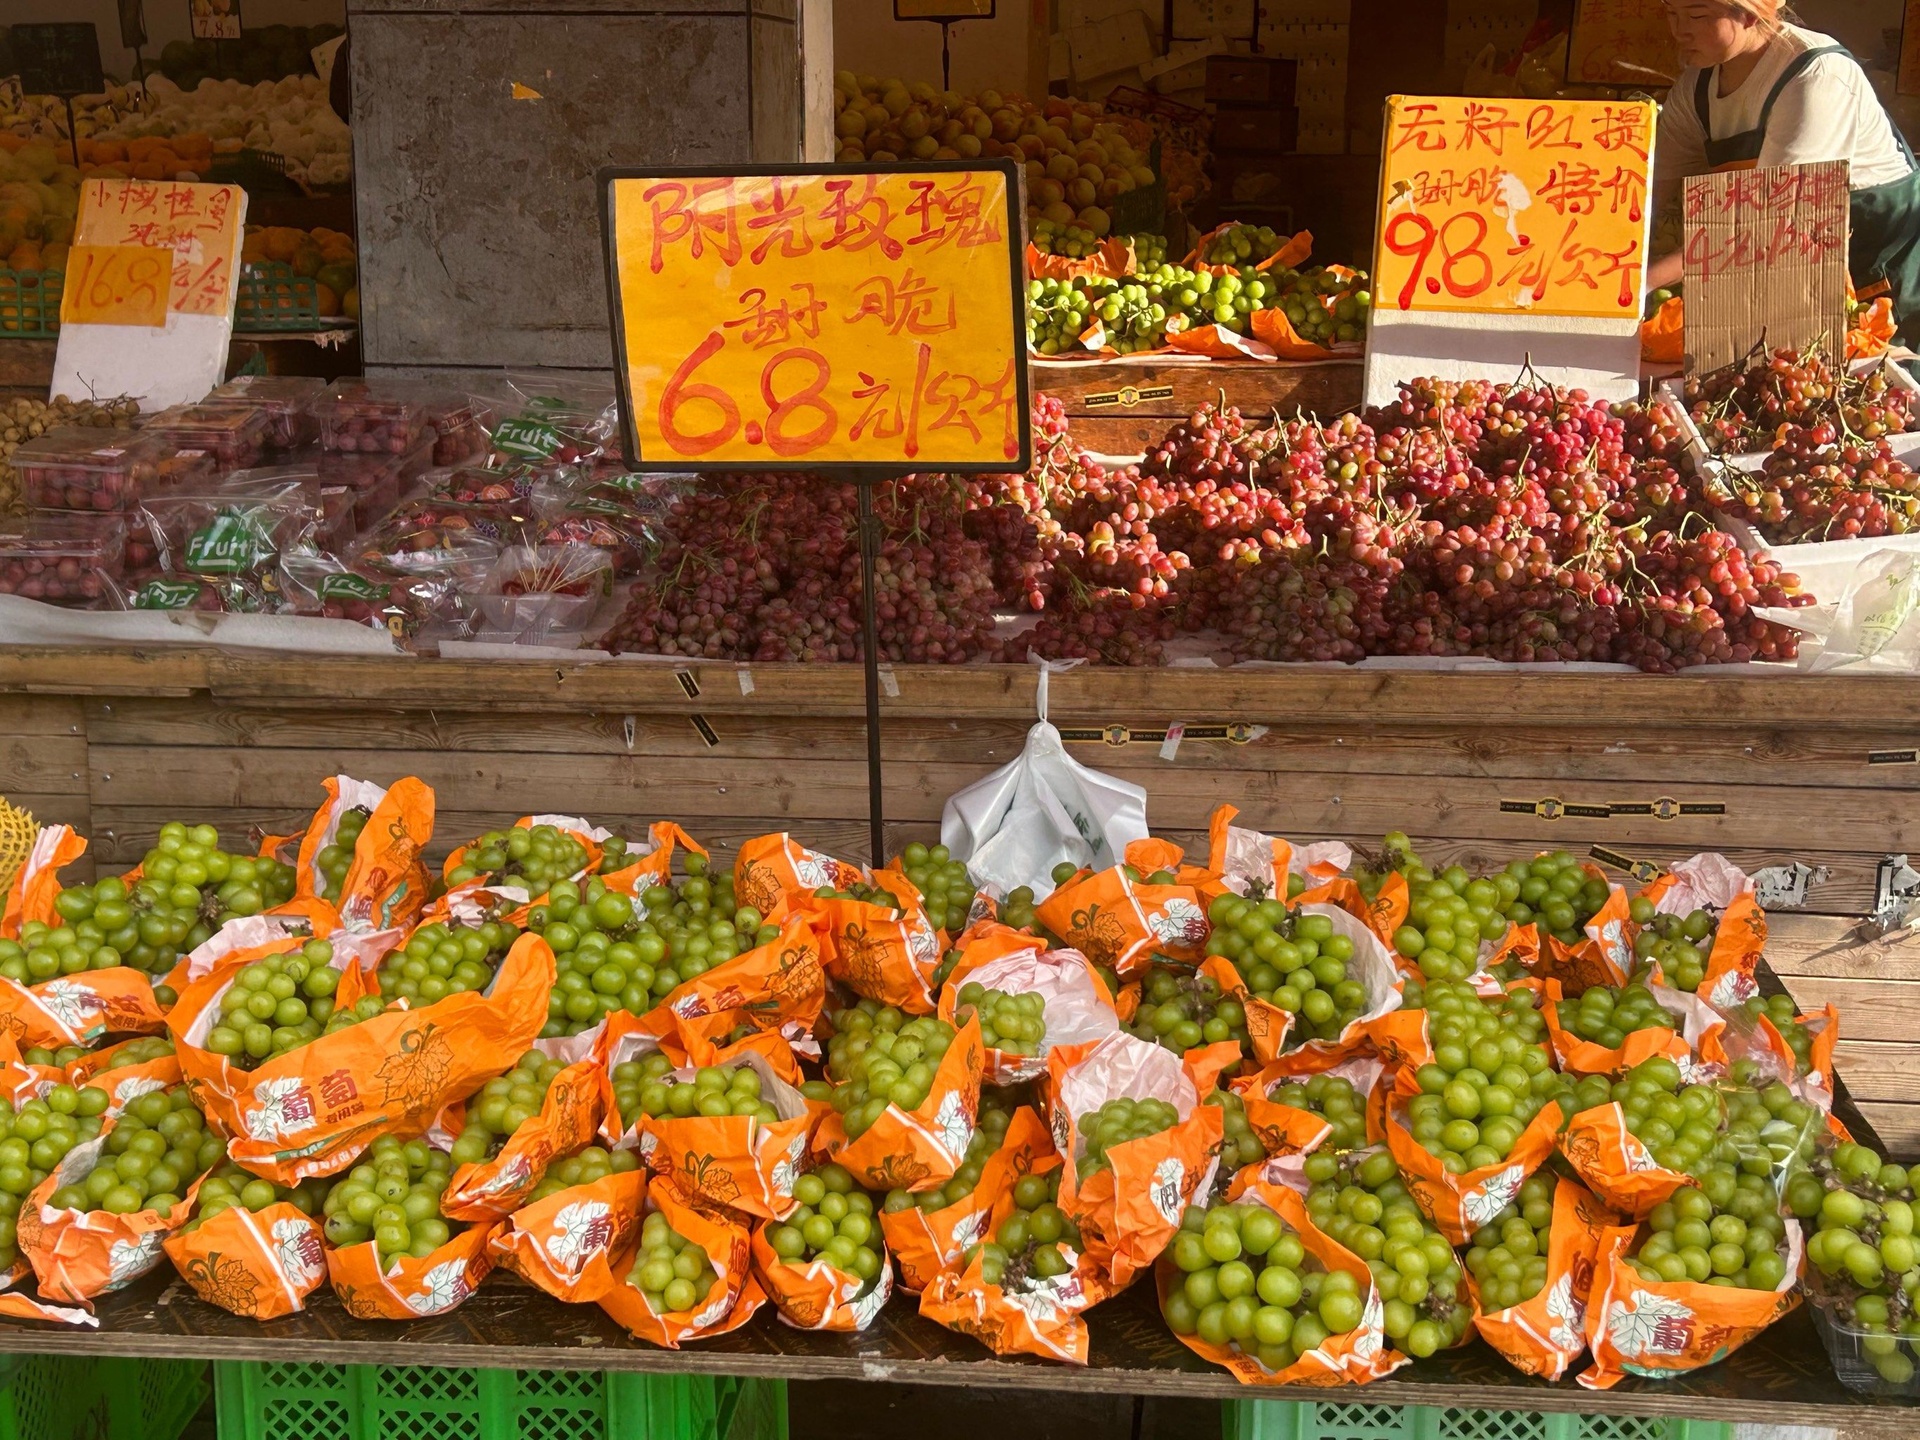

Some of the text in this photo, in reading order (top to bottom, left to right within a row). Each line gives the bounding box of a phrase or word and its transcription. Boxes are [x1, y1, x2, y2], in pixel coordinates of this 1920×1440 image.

[1392, 102, 1649, 162] 无籽红提
[1537, 161, 1647, 223] 特价
[643, 172, 1002, 274] 阳光玫瑰
[723, 268, 957, 349] 甜脆
[496, 423, 556, 449] Fruit
[189, 536, 248, 558] Fruit
[278, 1069, 358, 1124] 葡萄
